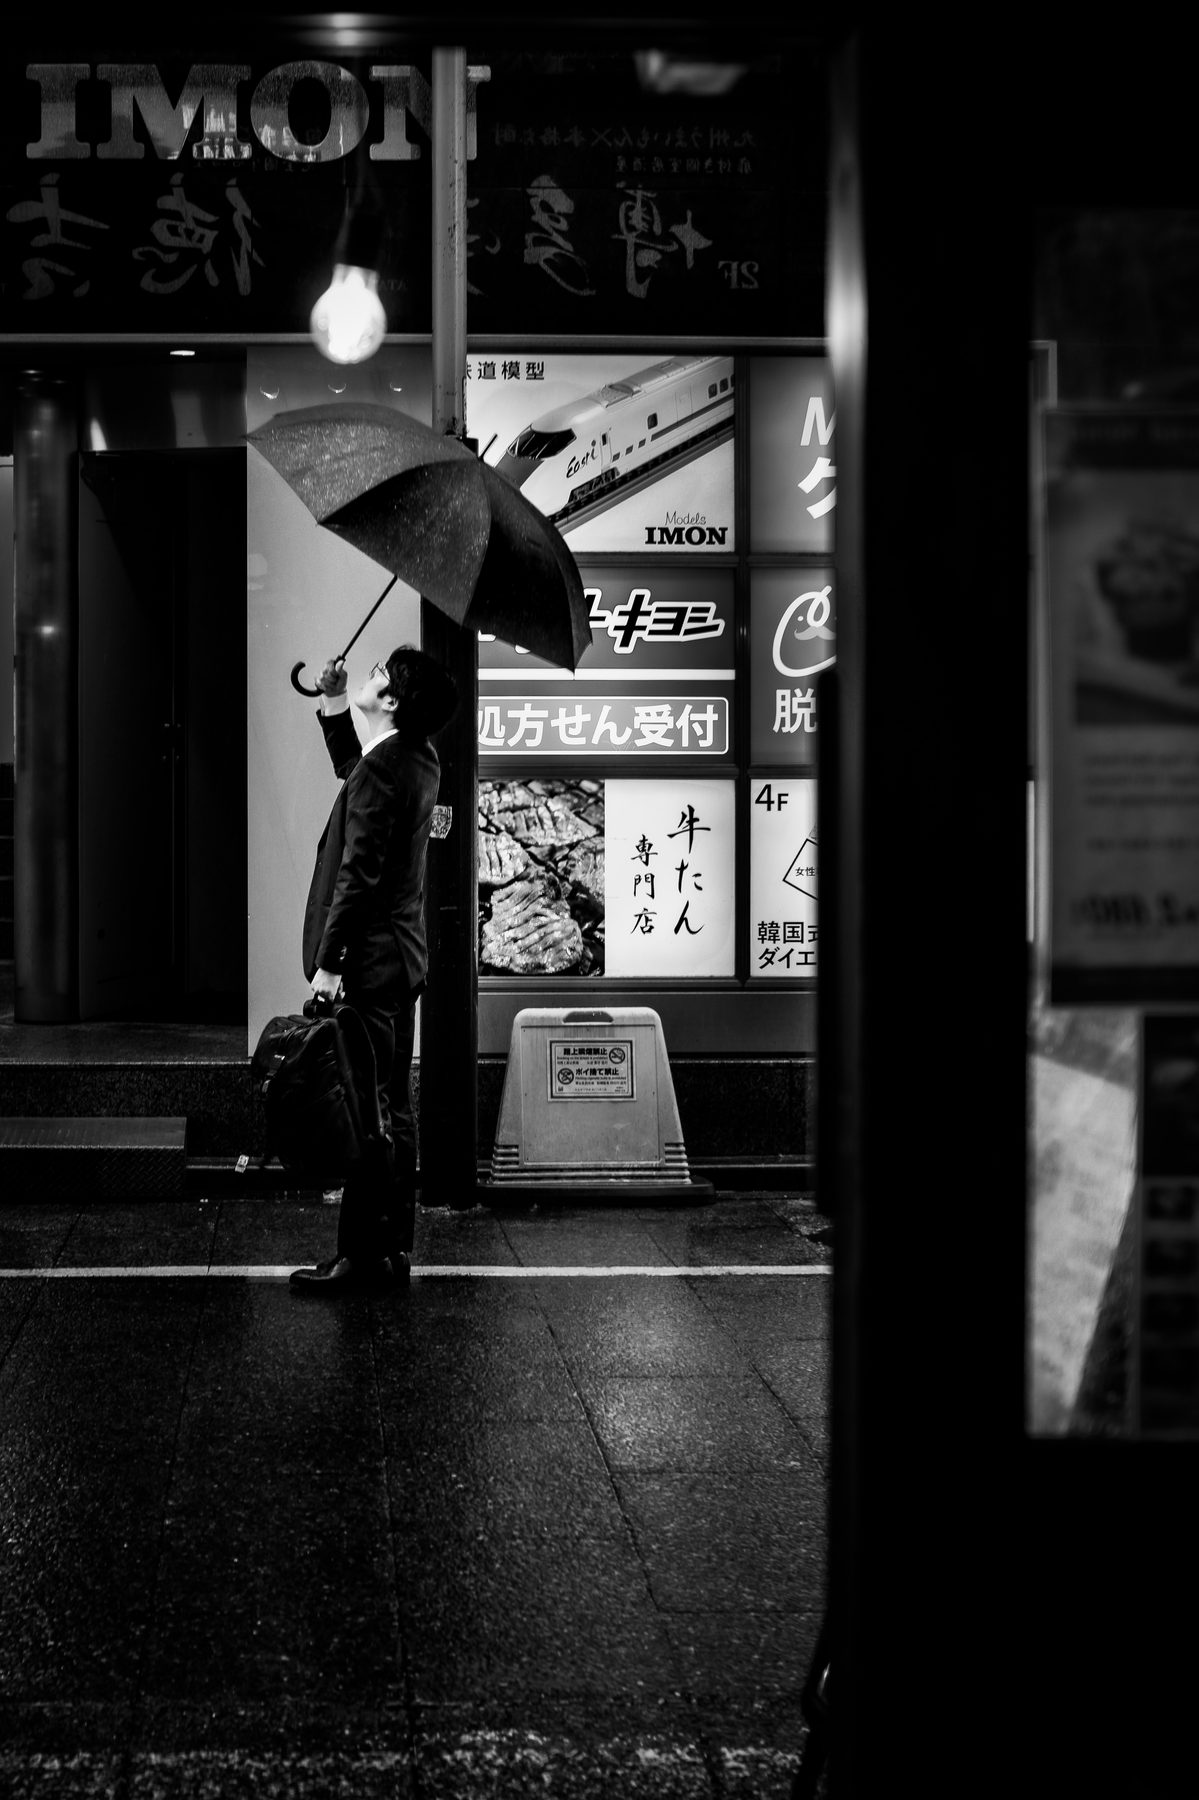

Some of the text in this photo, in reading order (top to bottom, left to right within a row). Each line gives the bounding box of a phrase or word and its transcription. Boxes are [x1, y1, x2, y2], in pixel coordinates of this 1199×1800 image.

[25, 60, 492, 163] IMON
[645, 526, 728, 545] IMON
[665, 511, 707, 526] Models
[478, 703, 719, 748] 処方せん受付
[755, 784, 789, 812] 4F
[630, 833, 659, 936] 専門店
[667, 804, 712, 936] 牛たん
[795, 866, 818, 877] 女性
